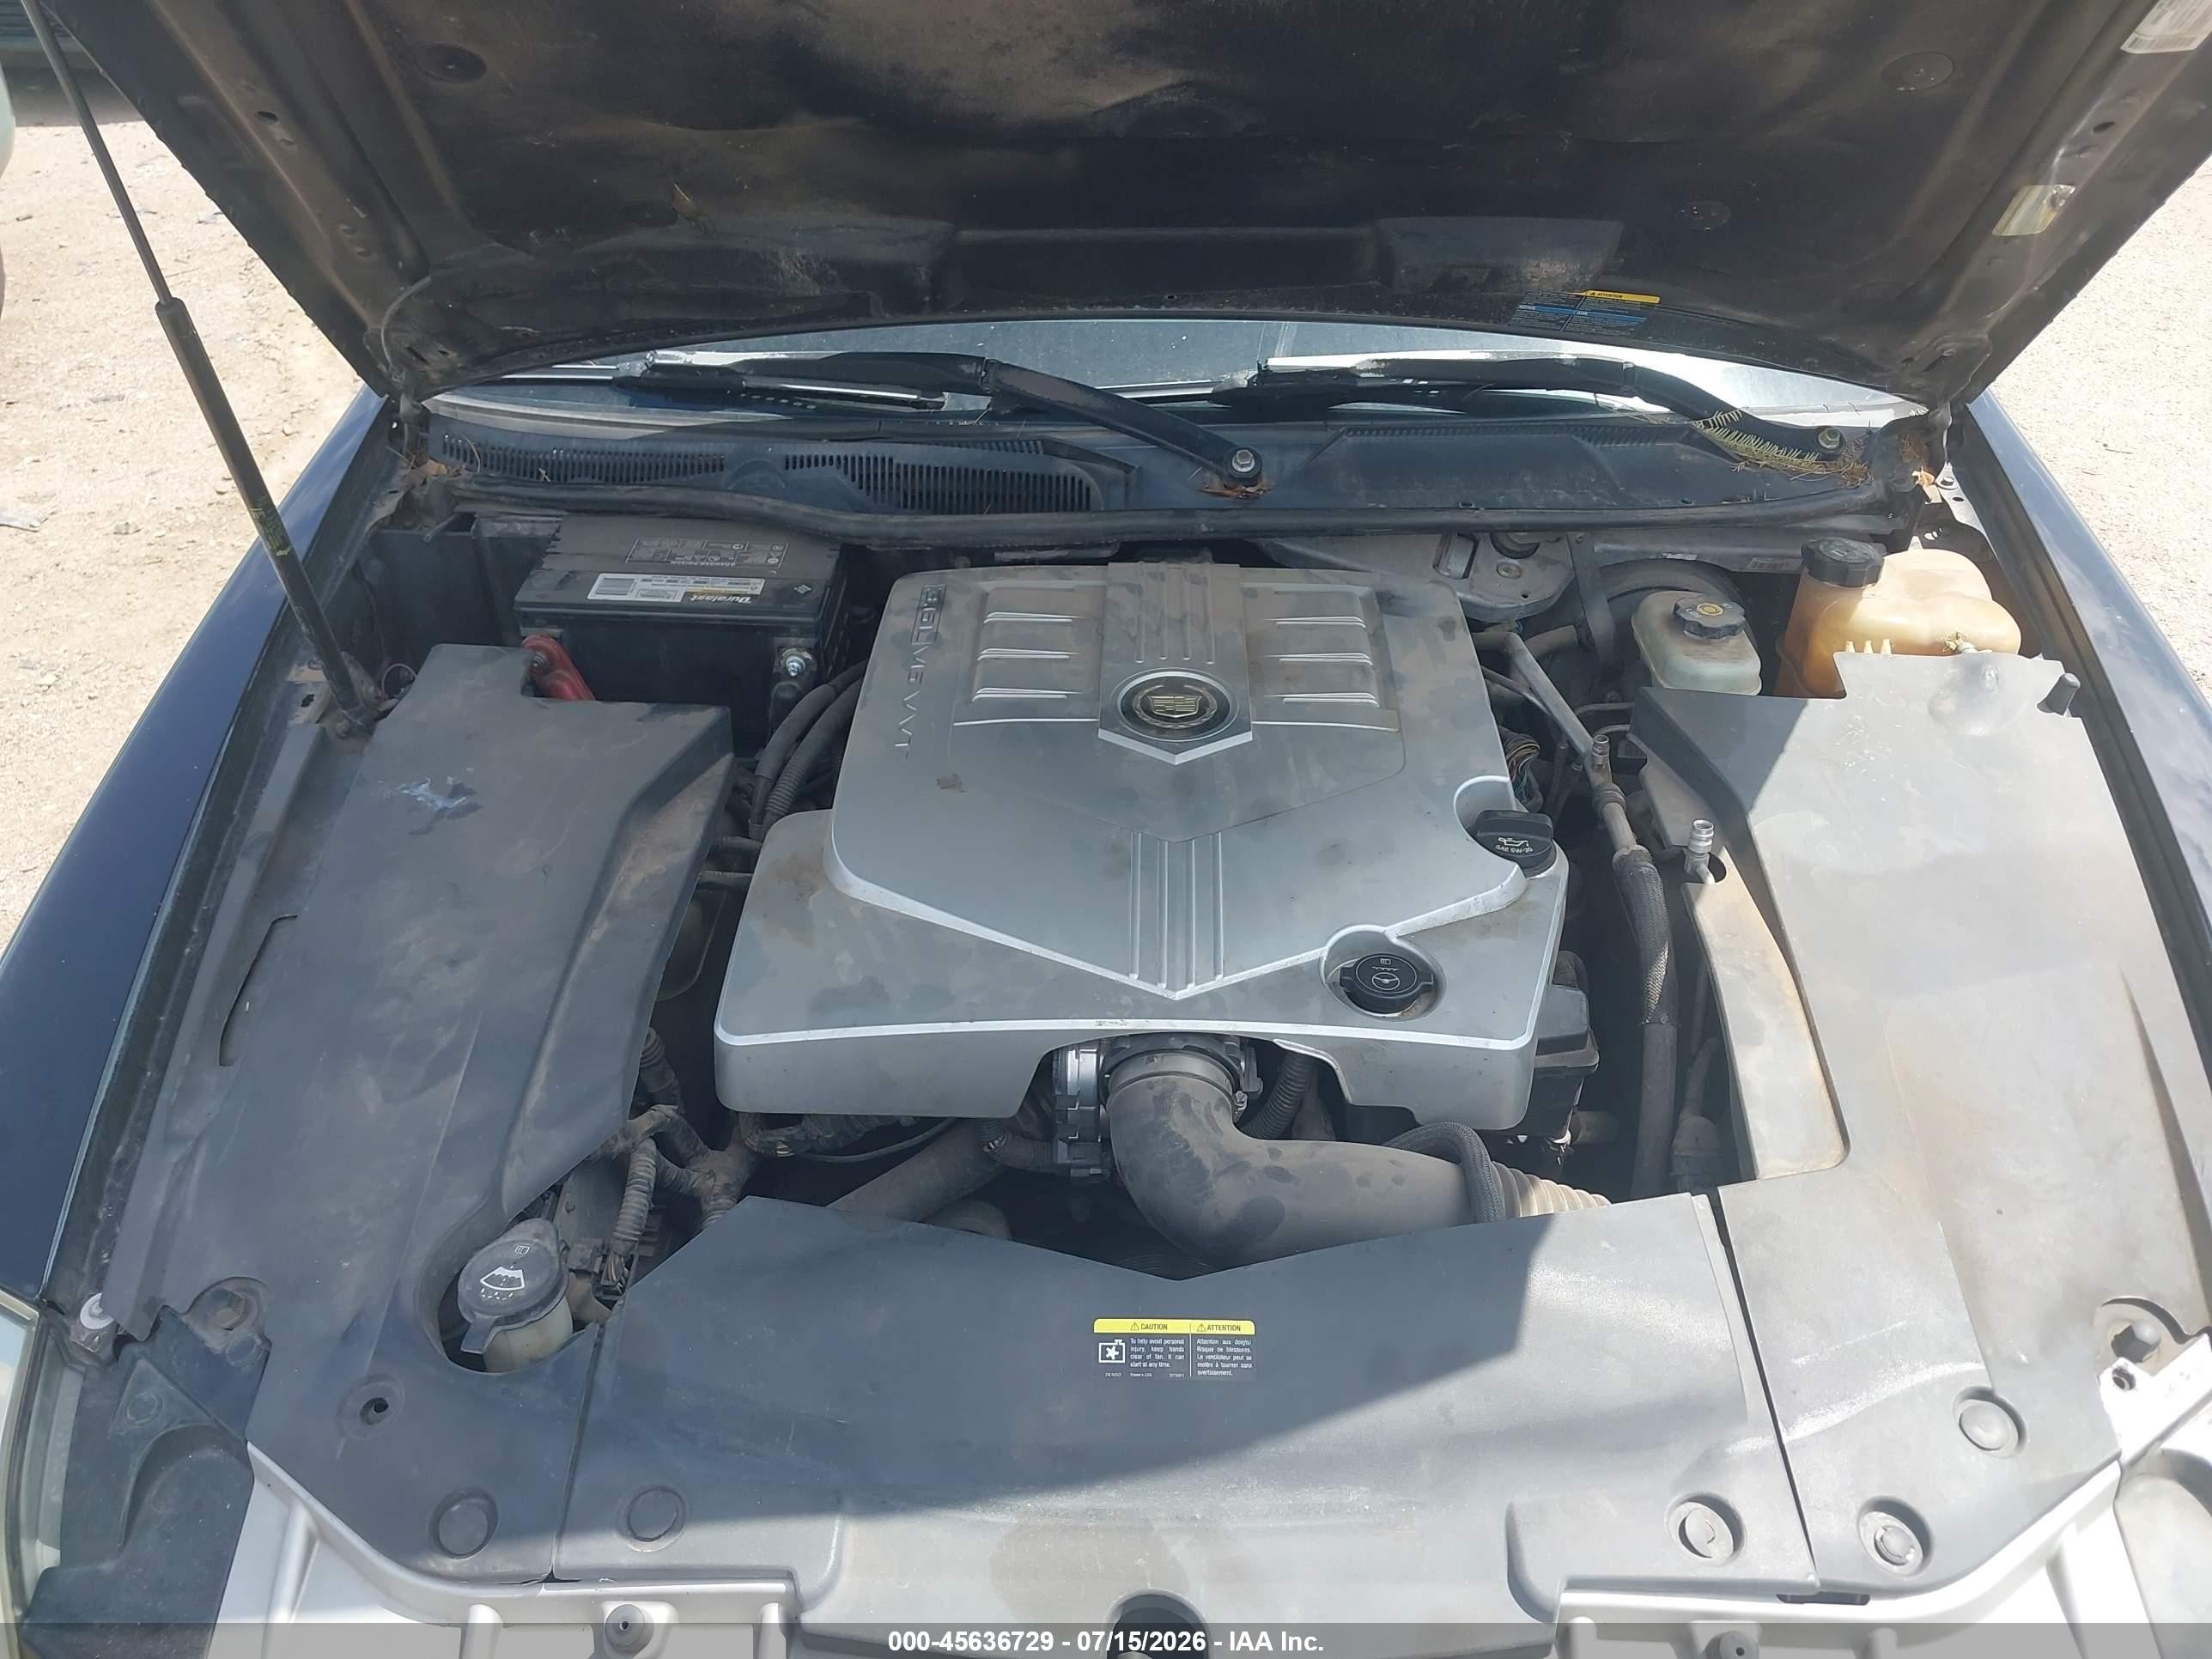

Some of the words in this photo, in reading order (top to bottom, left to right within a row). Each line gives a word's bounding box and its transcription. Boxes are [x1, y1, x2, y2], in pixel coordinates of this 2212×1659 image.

[690, 592, 752, 605] Duralast
[915, 587, 943, 642] 3.6L
[907, 644, 928, 684] V6
[895, 690, 921, 760] VVT
[1495, 844, 1510, 853] SAE
